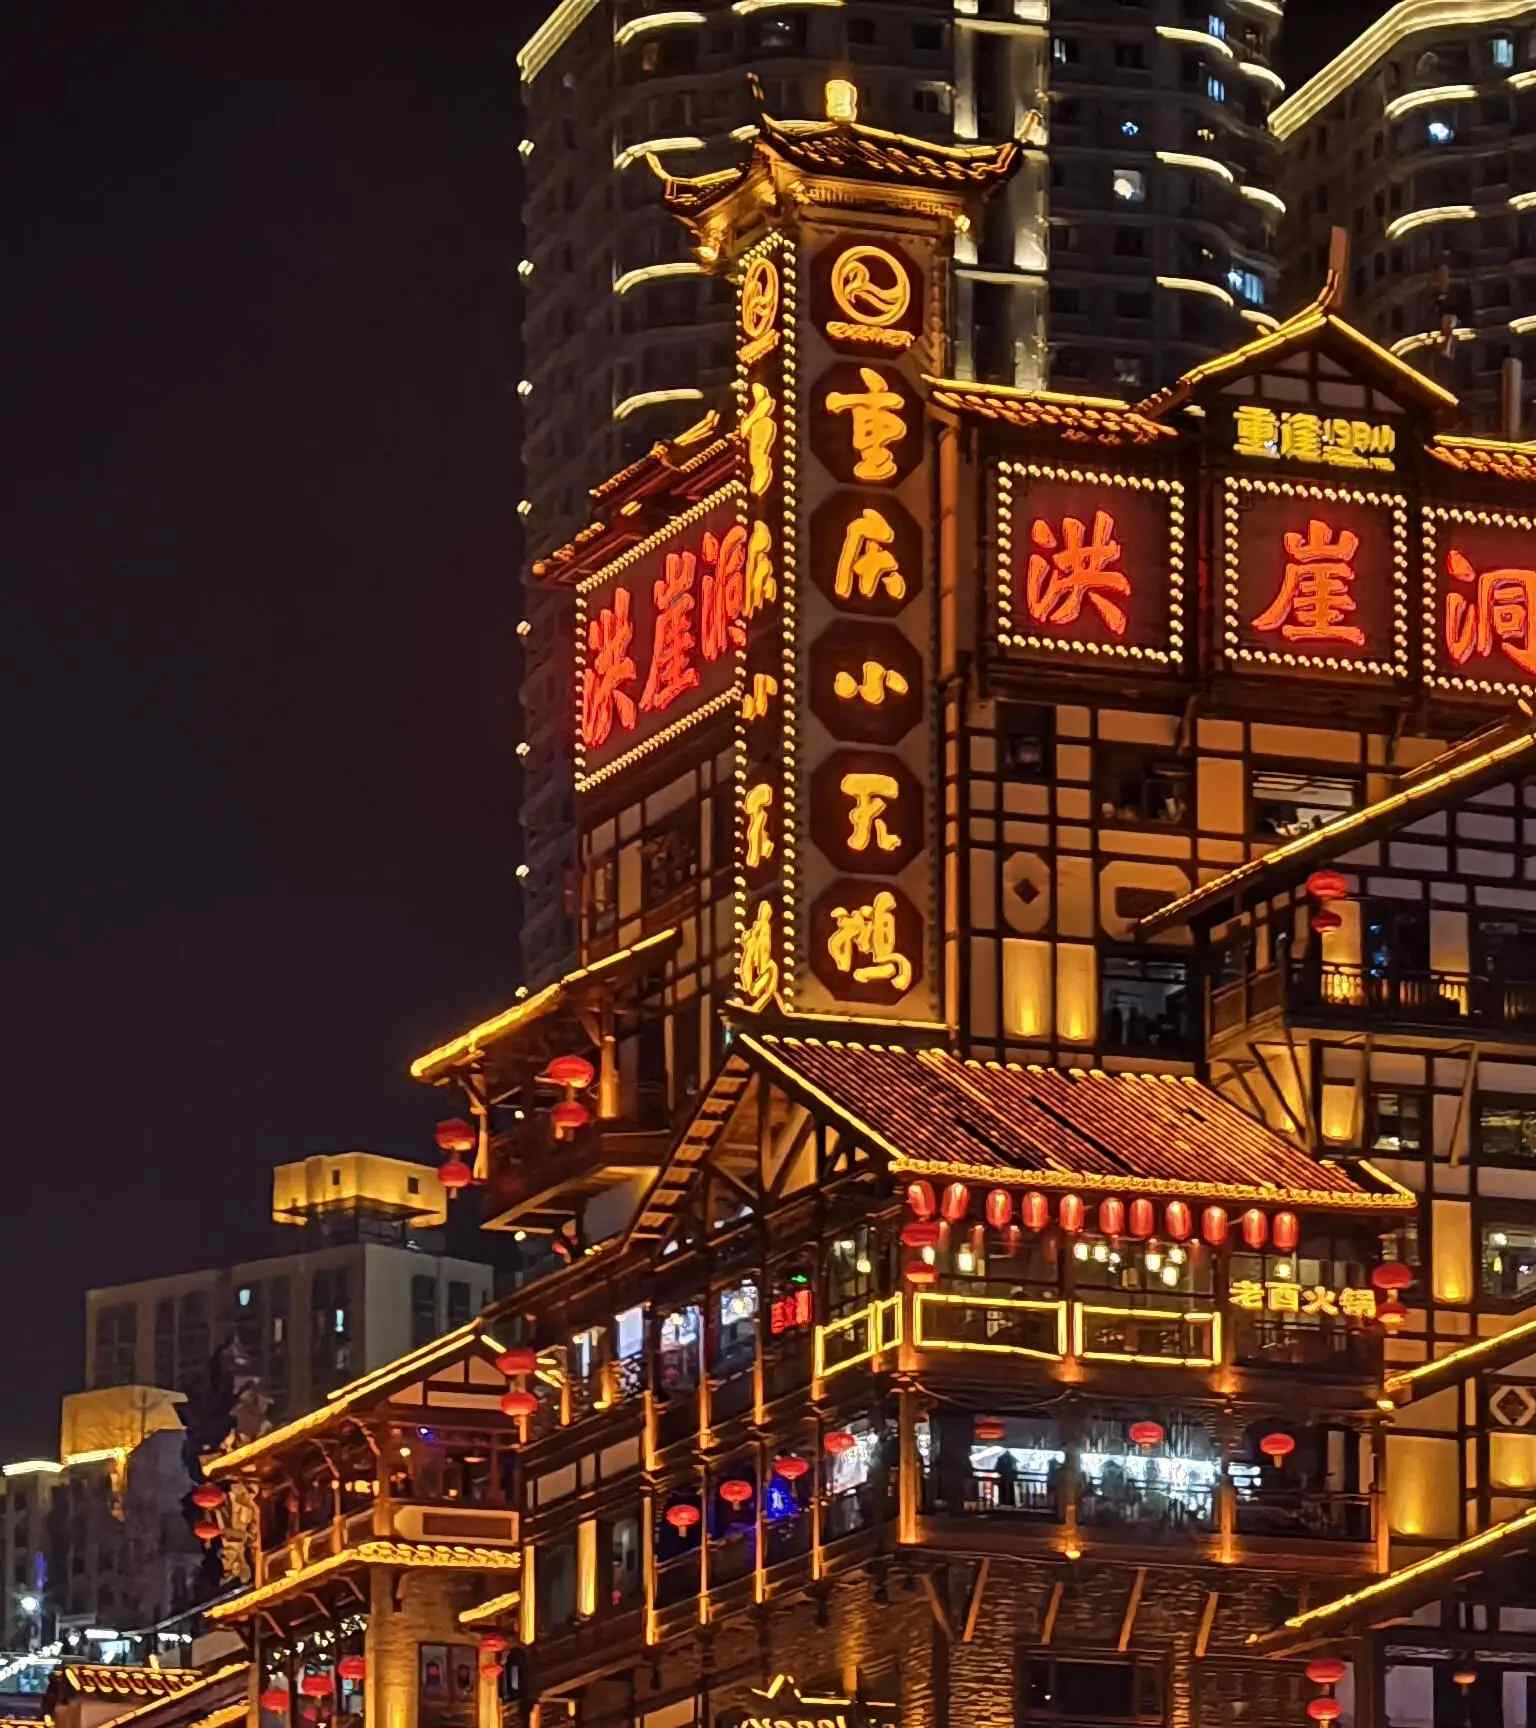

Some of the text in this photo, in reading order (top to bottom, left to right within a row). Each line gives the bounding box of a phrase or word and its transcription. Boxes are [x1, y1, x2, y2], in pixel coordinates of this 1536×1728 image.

[582, 524, 748, 747] 洪崖洞
[826, 367, 911, 992] 重庆小天鹅
